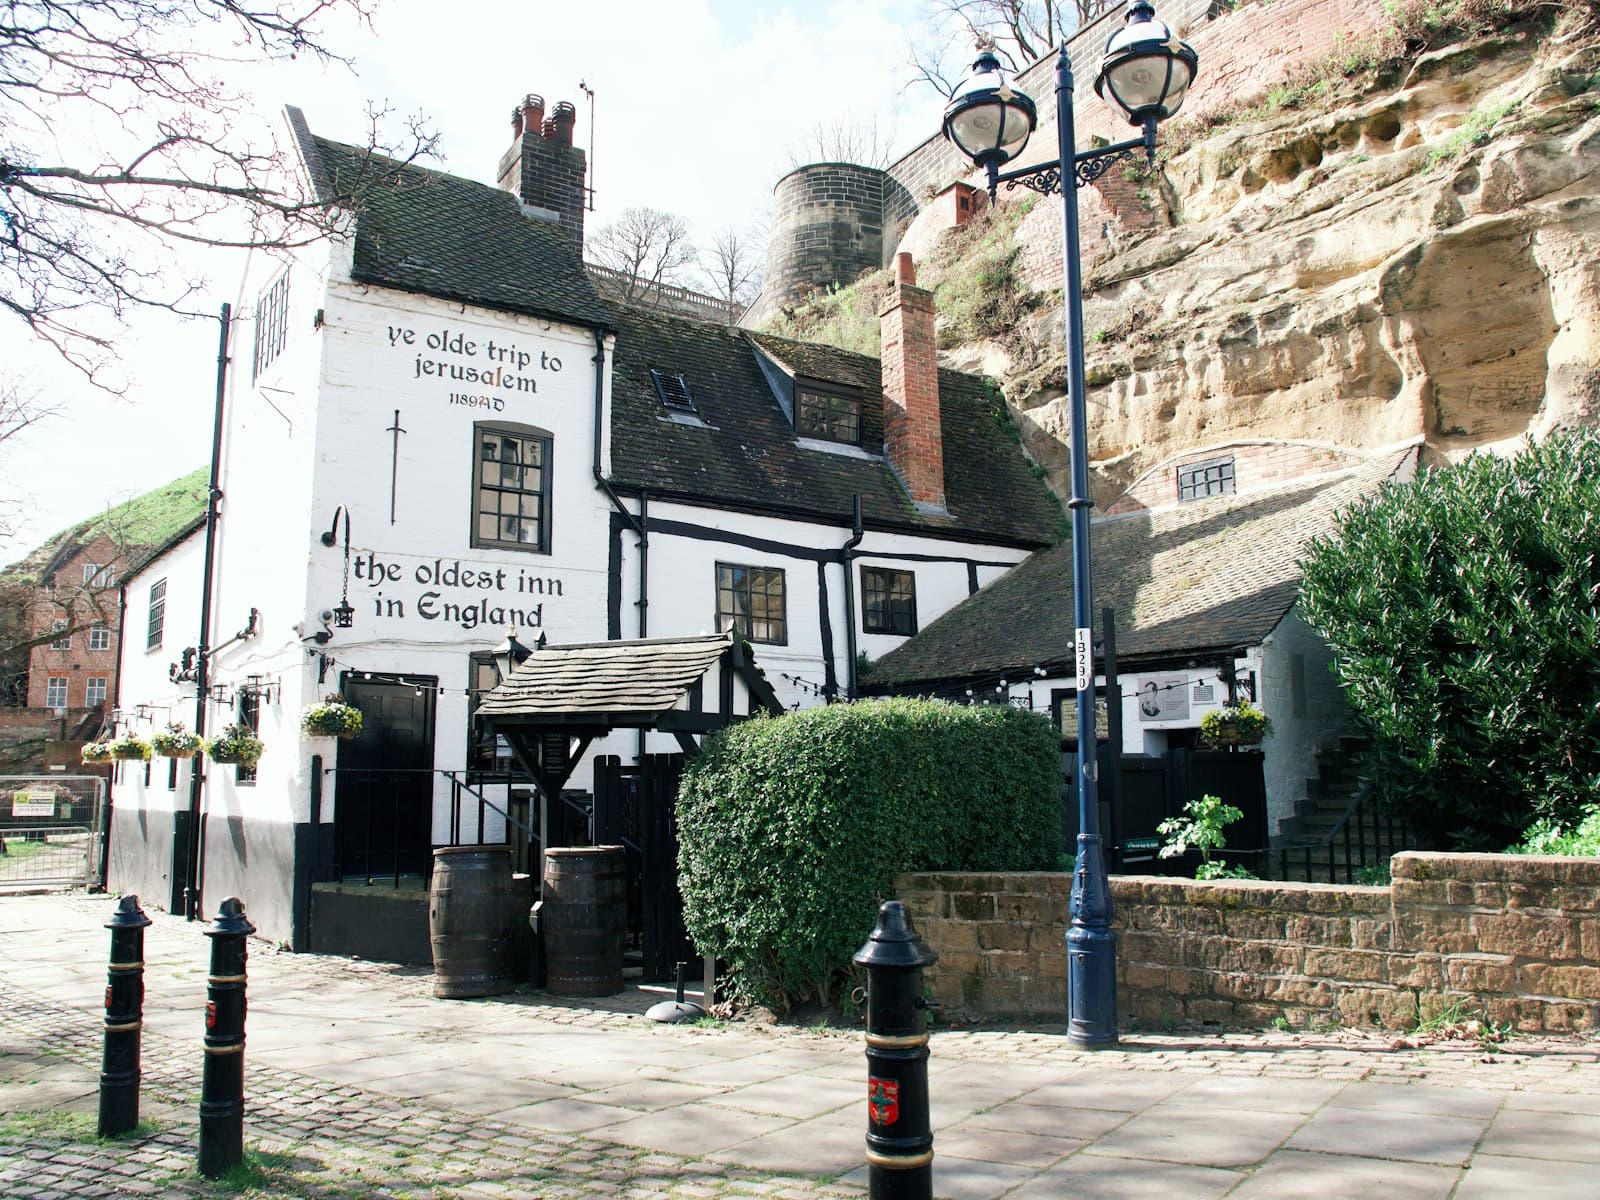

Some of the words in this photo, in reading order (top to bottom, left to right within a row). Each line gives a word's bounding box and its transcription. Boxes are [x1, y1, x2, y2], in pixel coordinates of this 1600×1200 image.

[387, 325, 416, 346] ye
[426, 330, 478, 356] olde
[487, 340, 532, 372] trip
[541, 349, 563, 373] to
[413, 353, 538, 394] jerusalem
[353, 551, 402, 588] the
[415, 559, 506, 592] oldest
[519, 569, 564, 597] inn
[375, 592, 405, 619] in
[417, 591, 543, 630] England
